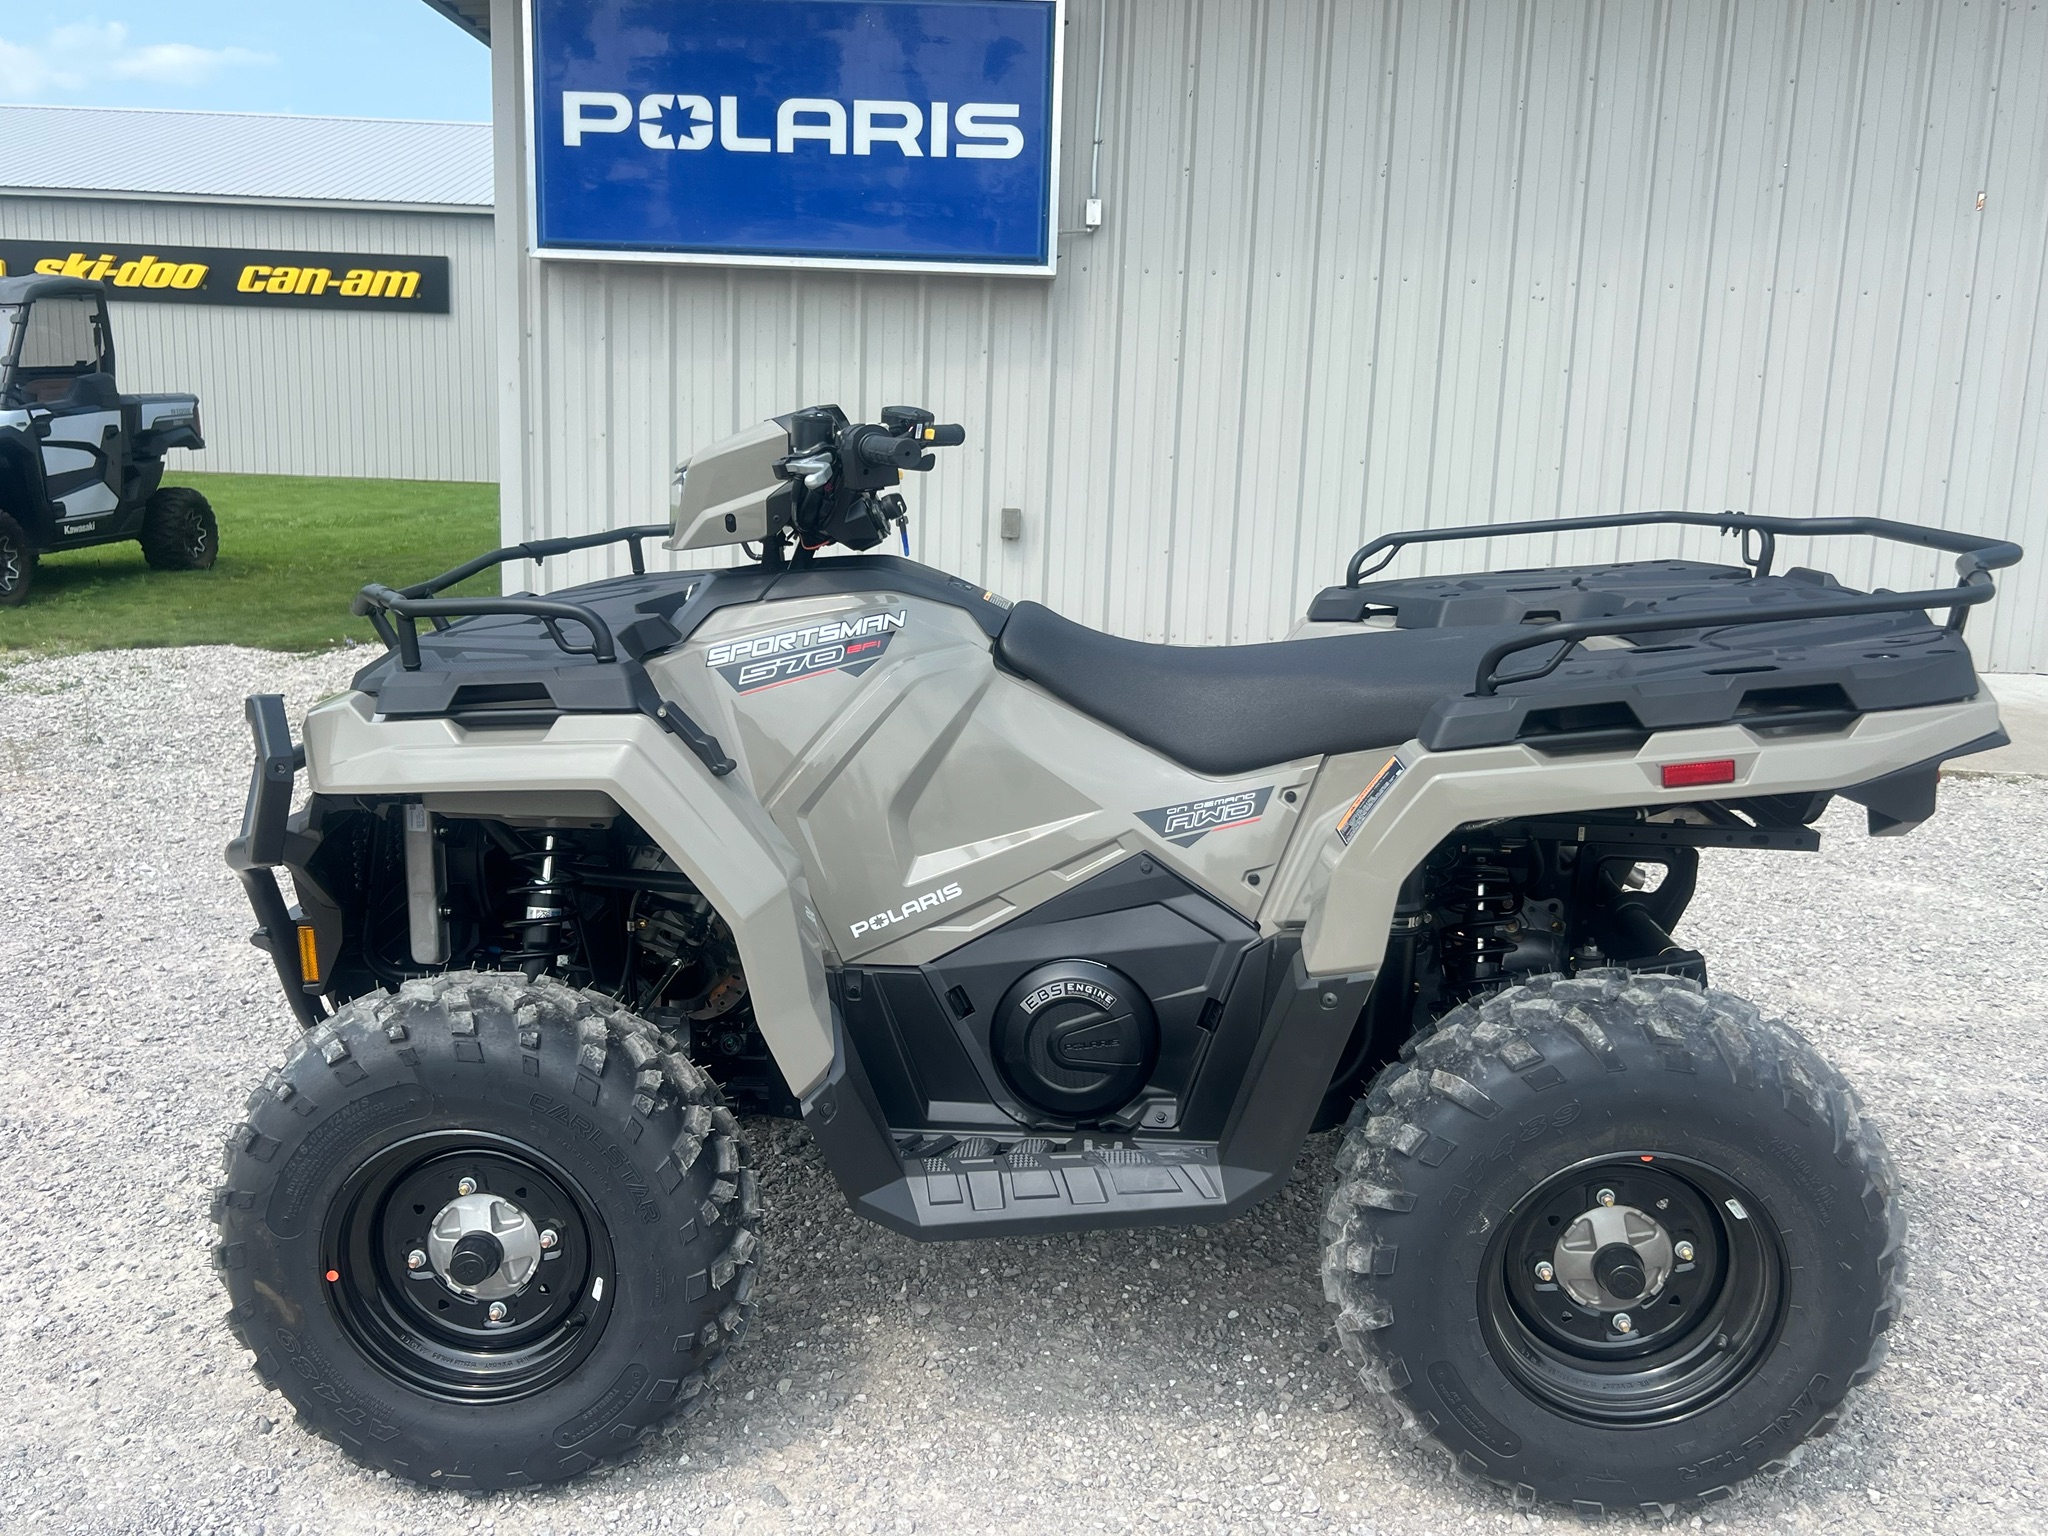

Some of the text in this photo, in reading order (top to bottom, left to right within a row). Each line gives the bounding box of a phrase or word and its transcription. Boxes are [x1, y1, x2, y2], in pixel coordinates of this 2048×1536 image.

[563, 91, 1024, 160] POLARIS
[34, 253, 209, 289] ski-doo
[237, 265, 421, 298] can-am
[64, 521, 95, 535] Kawasaki
[706, 610, 907, 667] SPORTSMAN
[739, 640, 881, 685] 570 EFI
[1165, 801, 1256, 833] AWD
[1167, 792, 1256, 815] ON DEMAND
[849, 882, 963, 939] POLARIS
[1026, 983, 1114, 1010] EBS ENGINE
[1064, 1038, 1120, 1052] POLARIS
[528, 1091, 661, 1224] CARLSTAR
[1677, 1372, 1831, 1484] CARLSTAR
